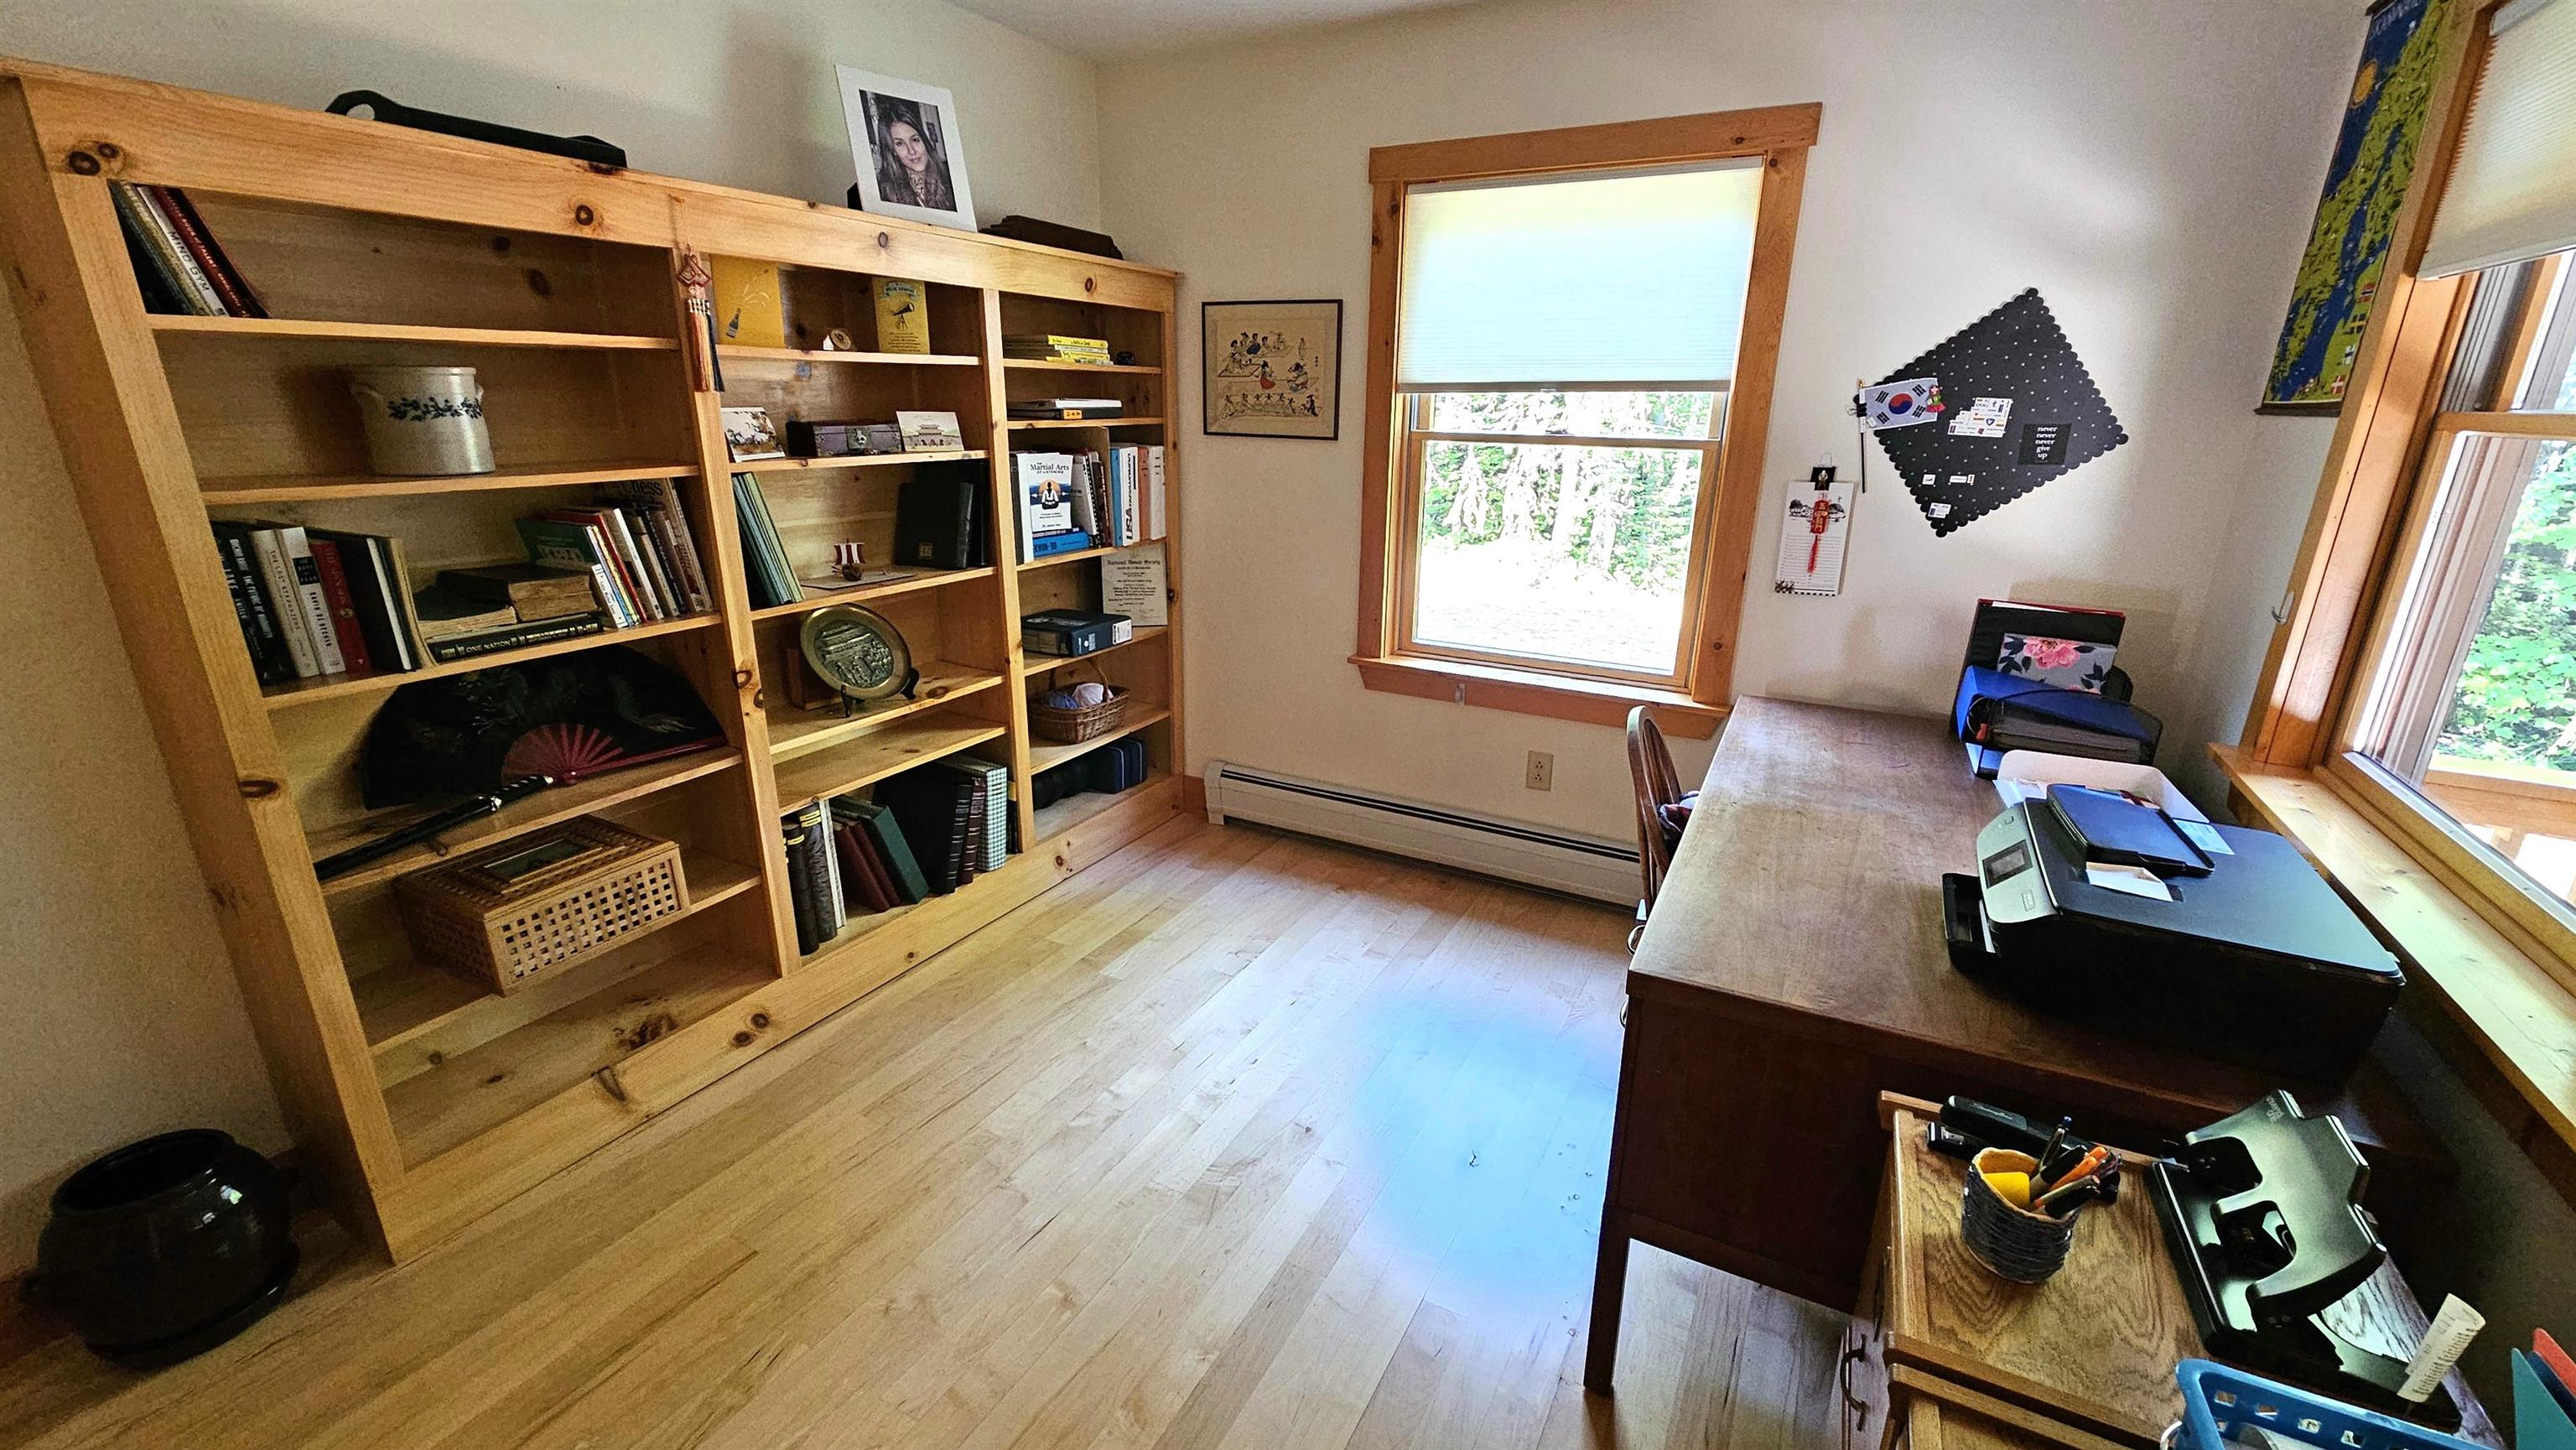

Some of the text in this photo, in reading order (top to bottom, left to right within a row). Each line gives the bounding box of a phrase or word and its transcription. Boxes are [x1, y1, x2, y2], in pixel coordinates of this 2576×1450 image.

[169, 231, 210, 292] MIND GYM
[2036, 444, 2051, 454] give
[465, 639, 512, 654] ONE NATION
